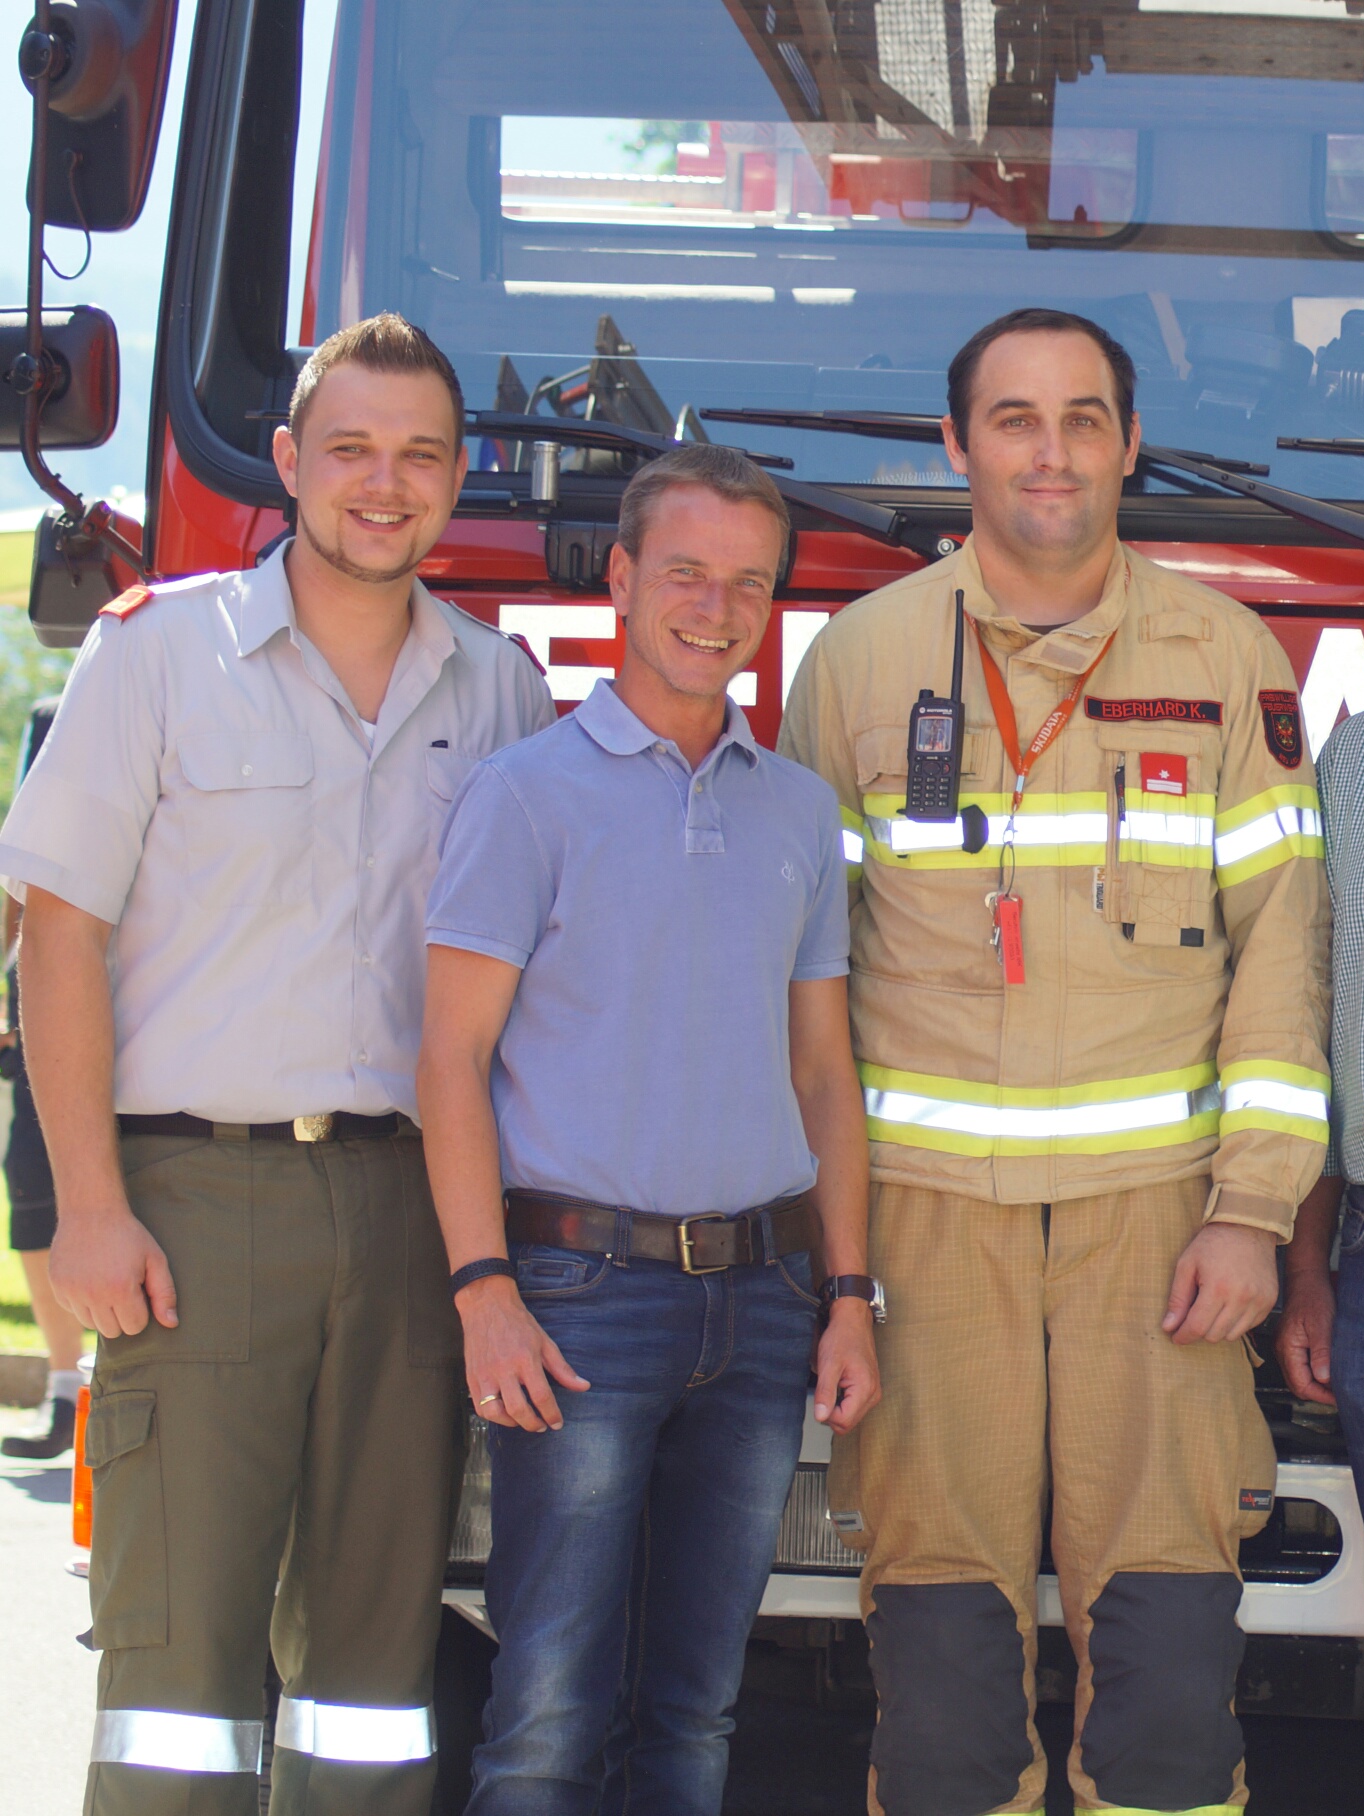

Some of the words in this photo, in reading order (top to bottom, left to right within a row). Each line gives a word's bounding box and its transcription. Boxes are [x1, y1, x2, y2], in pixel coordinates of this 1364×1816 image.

[1102, 701, 1187, 717] EBERHARD
[1190, 703, 1206, 719] K.
[1031, 711, 1062, 753] SKIDATA
